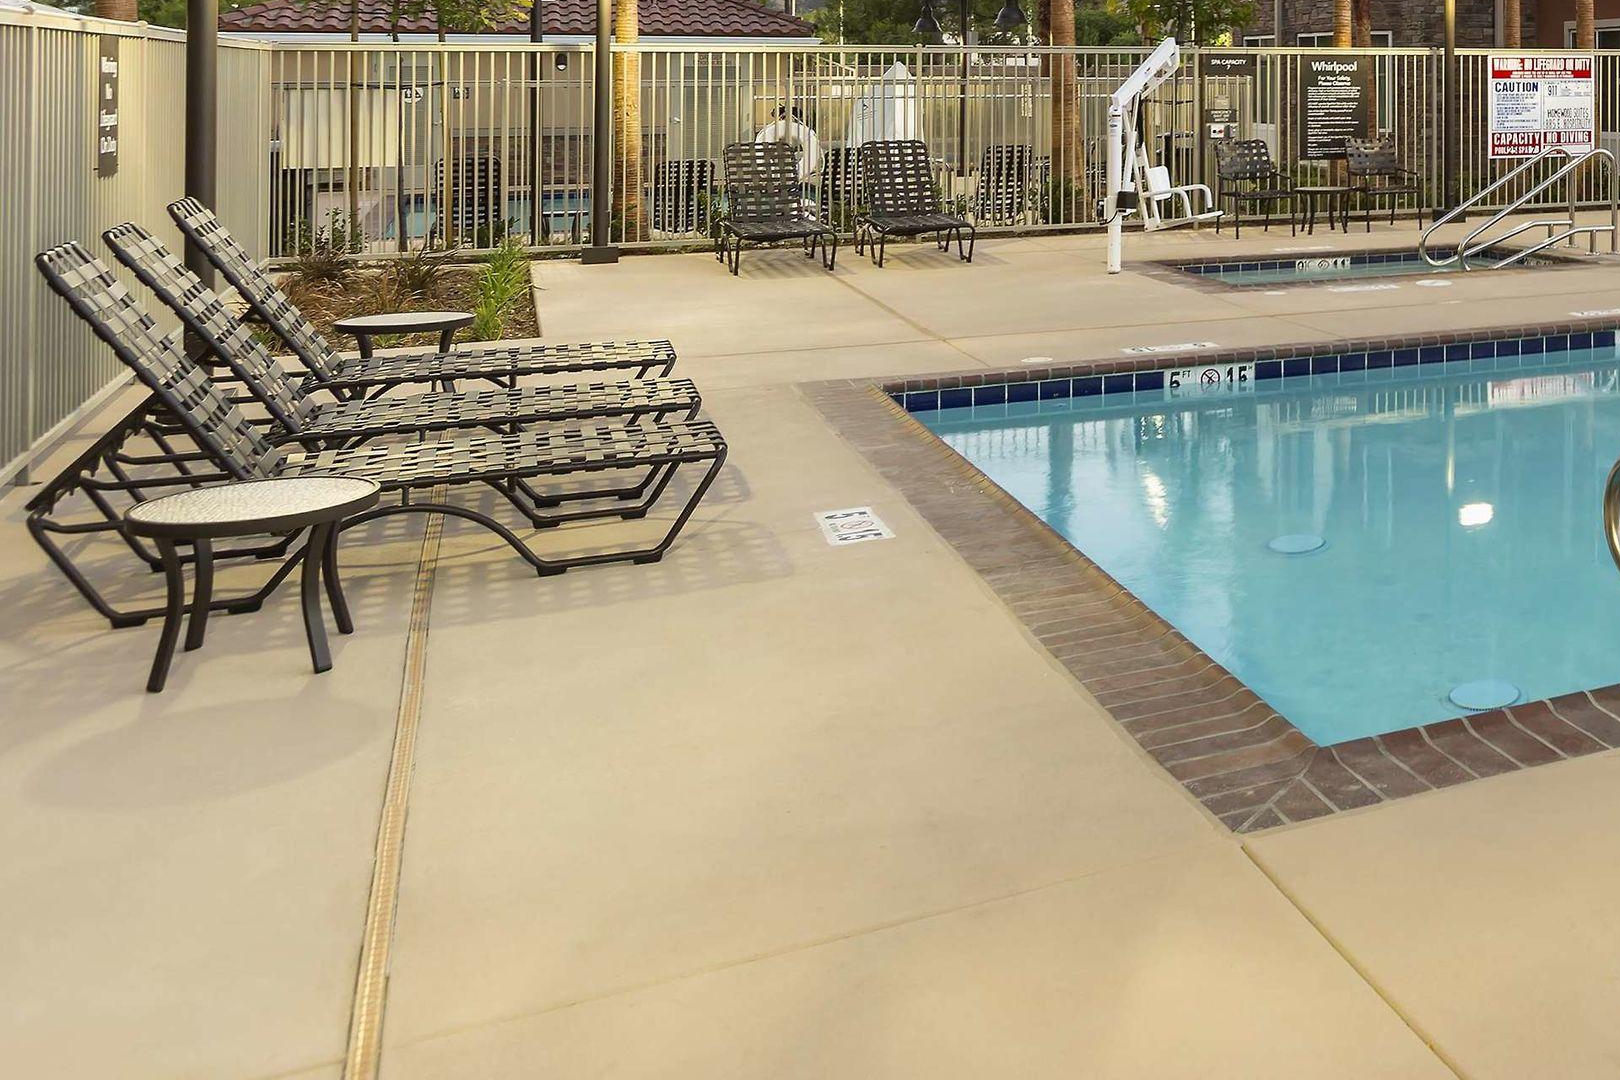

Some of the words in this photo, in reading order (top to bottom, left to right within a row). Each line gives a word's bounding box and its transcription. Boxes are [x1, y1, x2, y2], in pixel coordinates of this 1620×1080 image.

[1311, 61, 1358, 74] Whirlpool
[1495, 82, 1538, 92] CAUTION
[1548, 85, 1557, 96] 911
[1494, 132, 1540, 145] CAPACITY
[1547, 131, 1558, 142] NO
[1561, 131, 1589, 142] DIVING
[1170, 371, 1181, 388] 5
